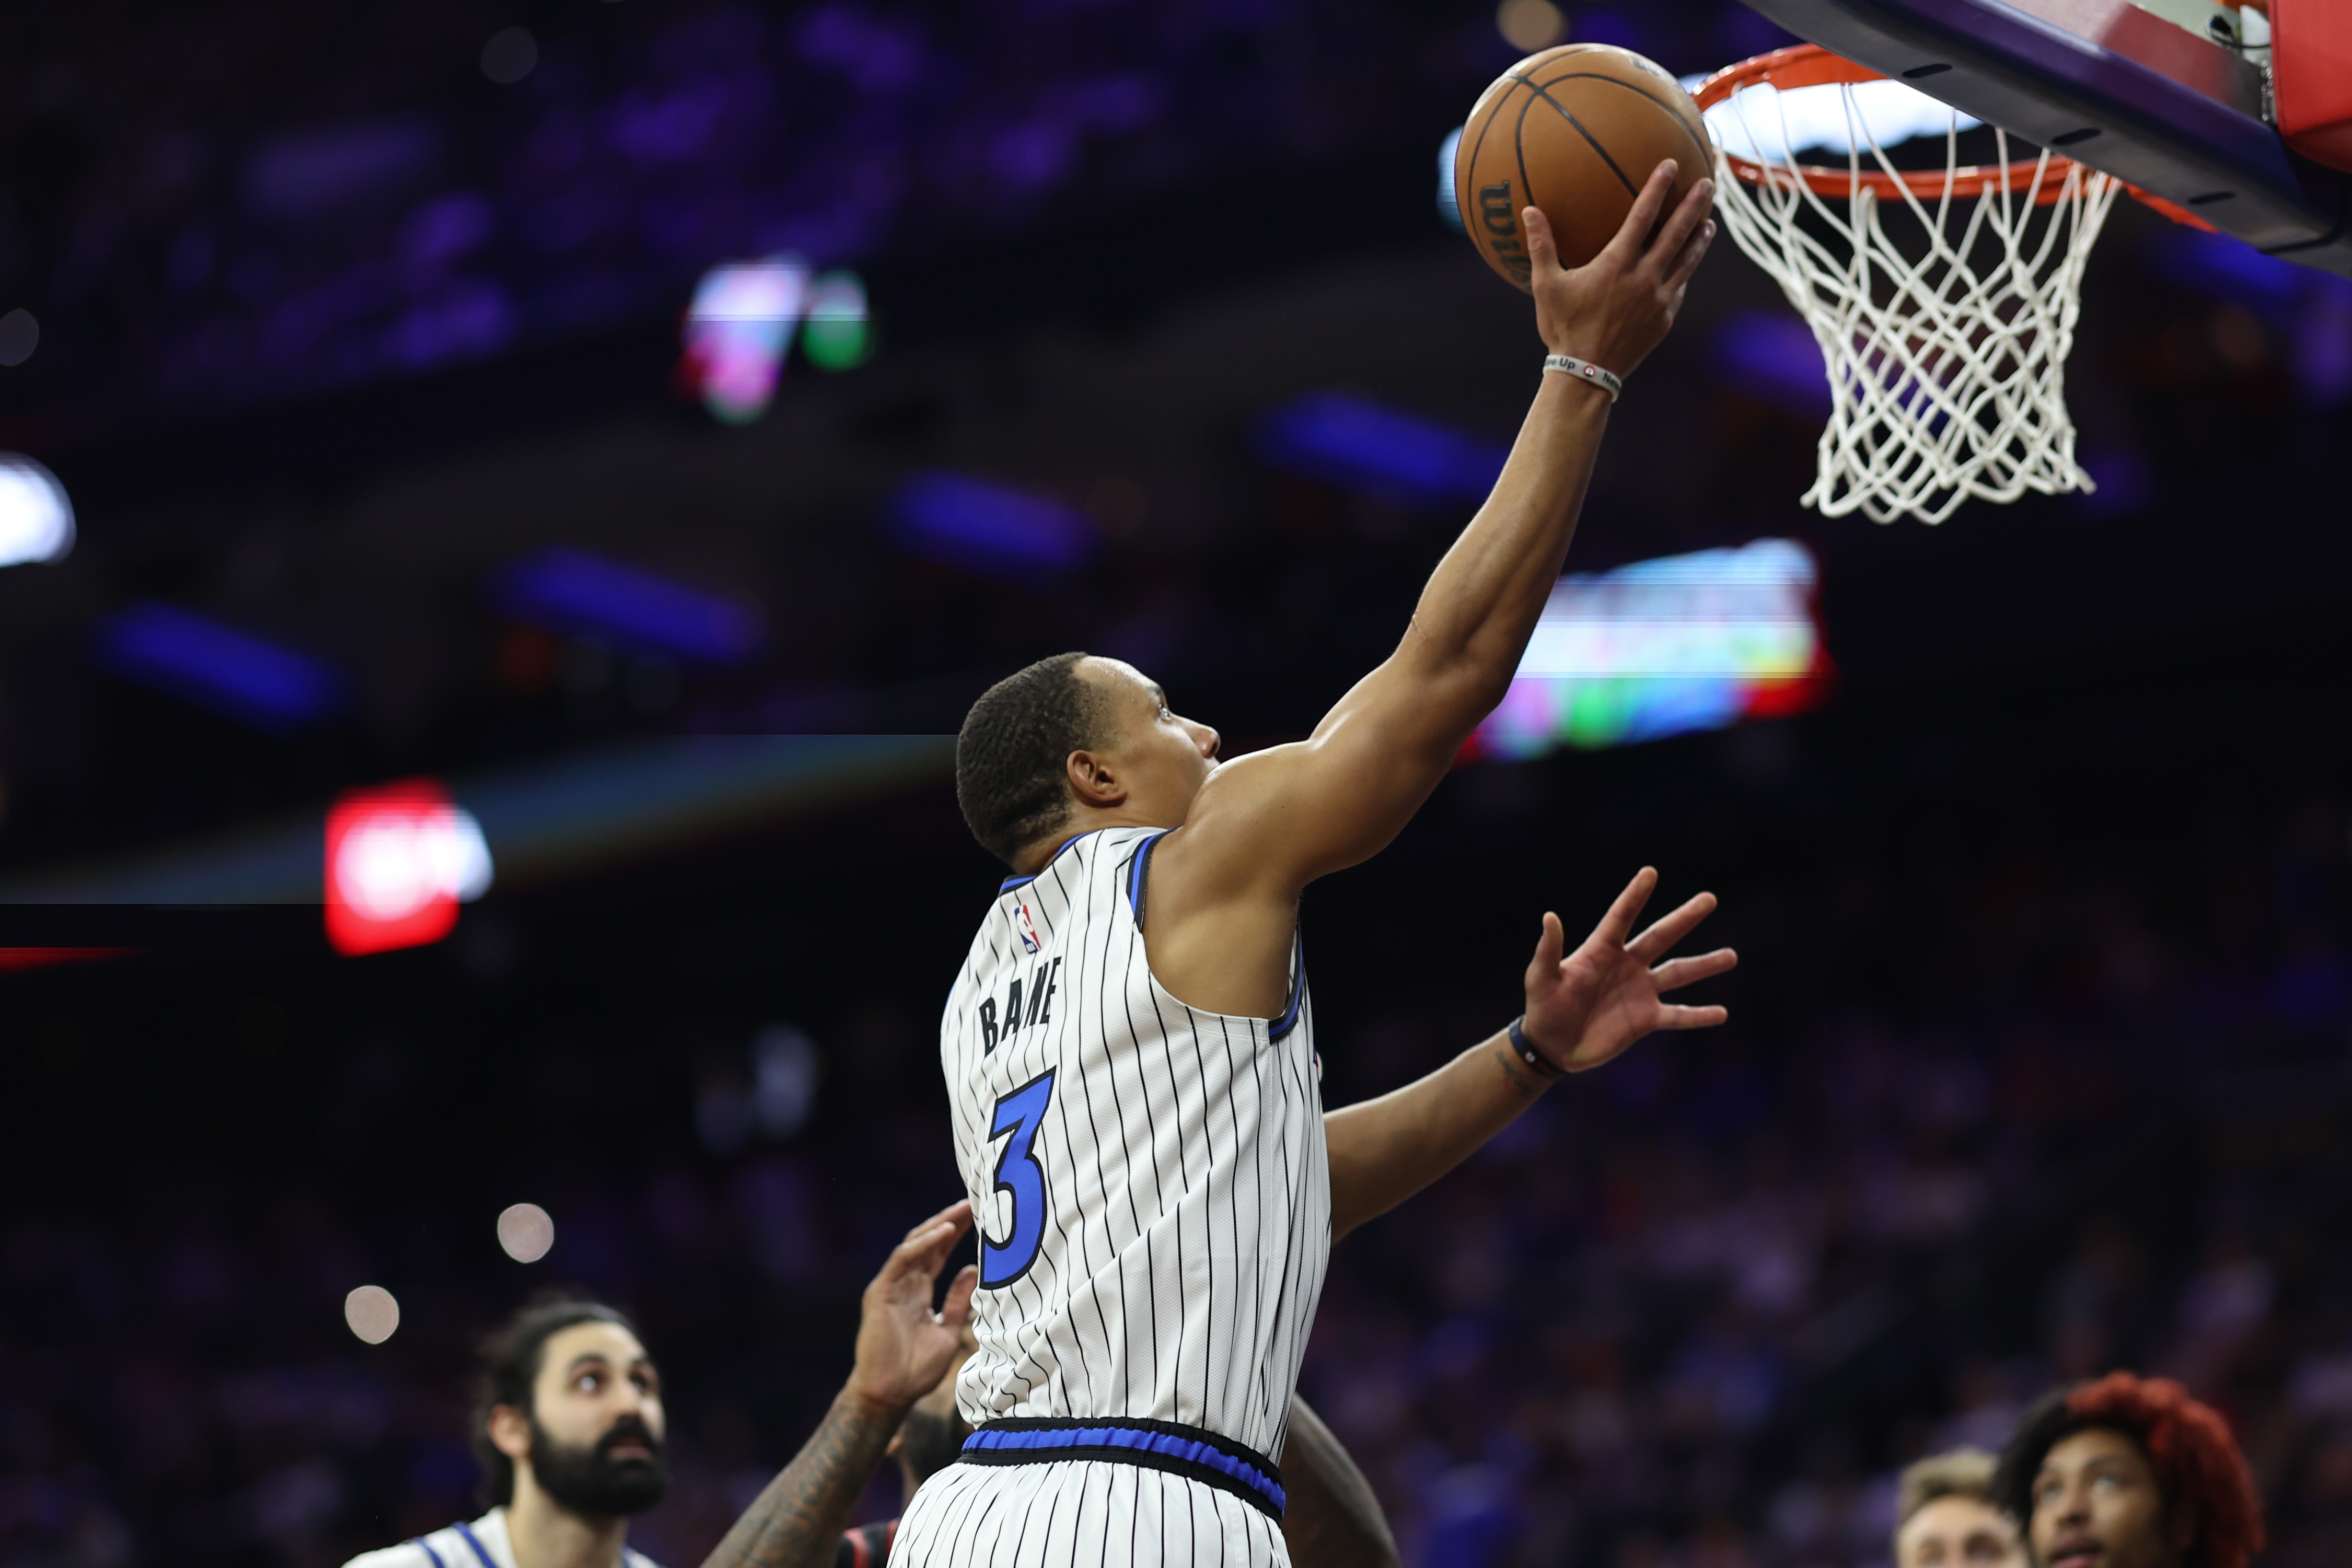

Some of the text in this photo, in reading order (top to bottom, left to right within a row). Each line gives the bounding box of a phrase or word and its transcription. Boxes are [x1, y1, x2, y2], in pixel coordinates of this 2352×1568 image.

[1559, 357, 1575, 370] Up
[979, 956, 1062, 1058] BANE
[979, 1064, 1057, 1290] 3
